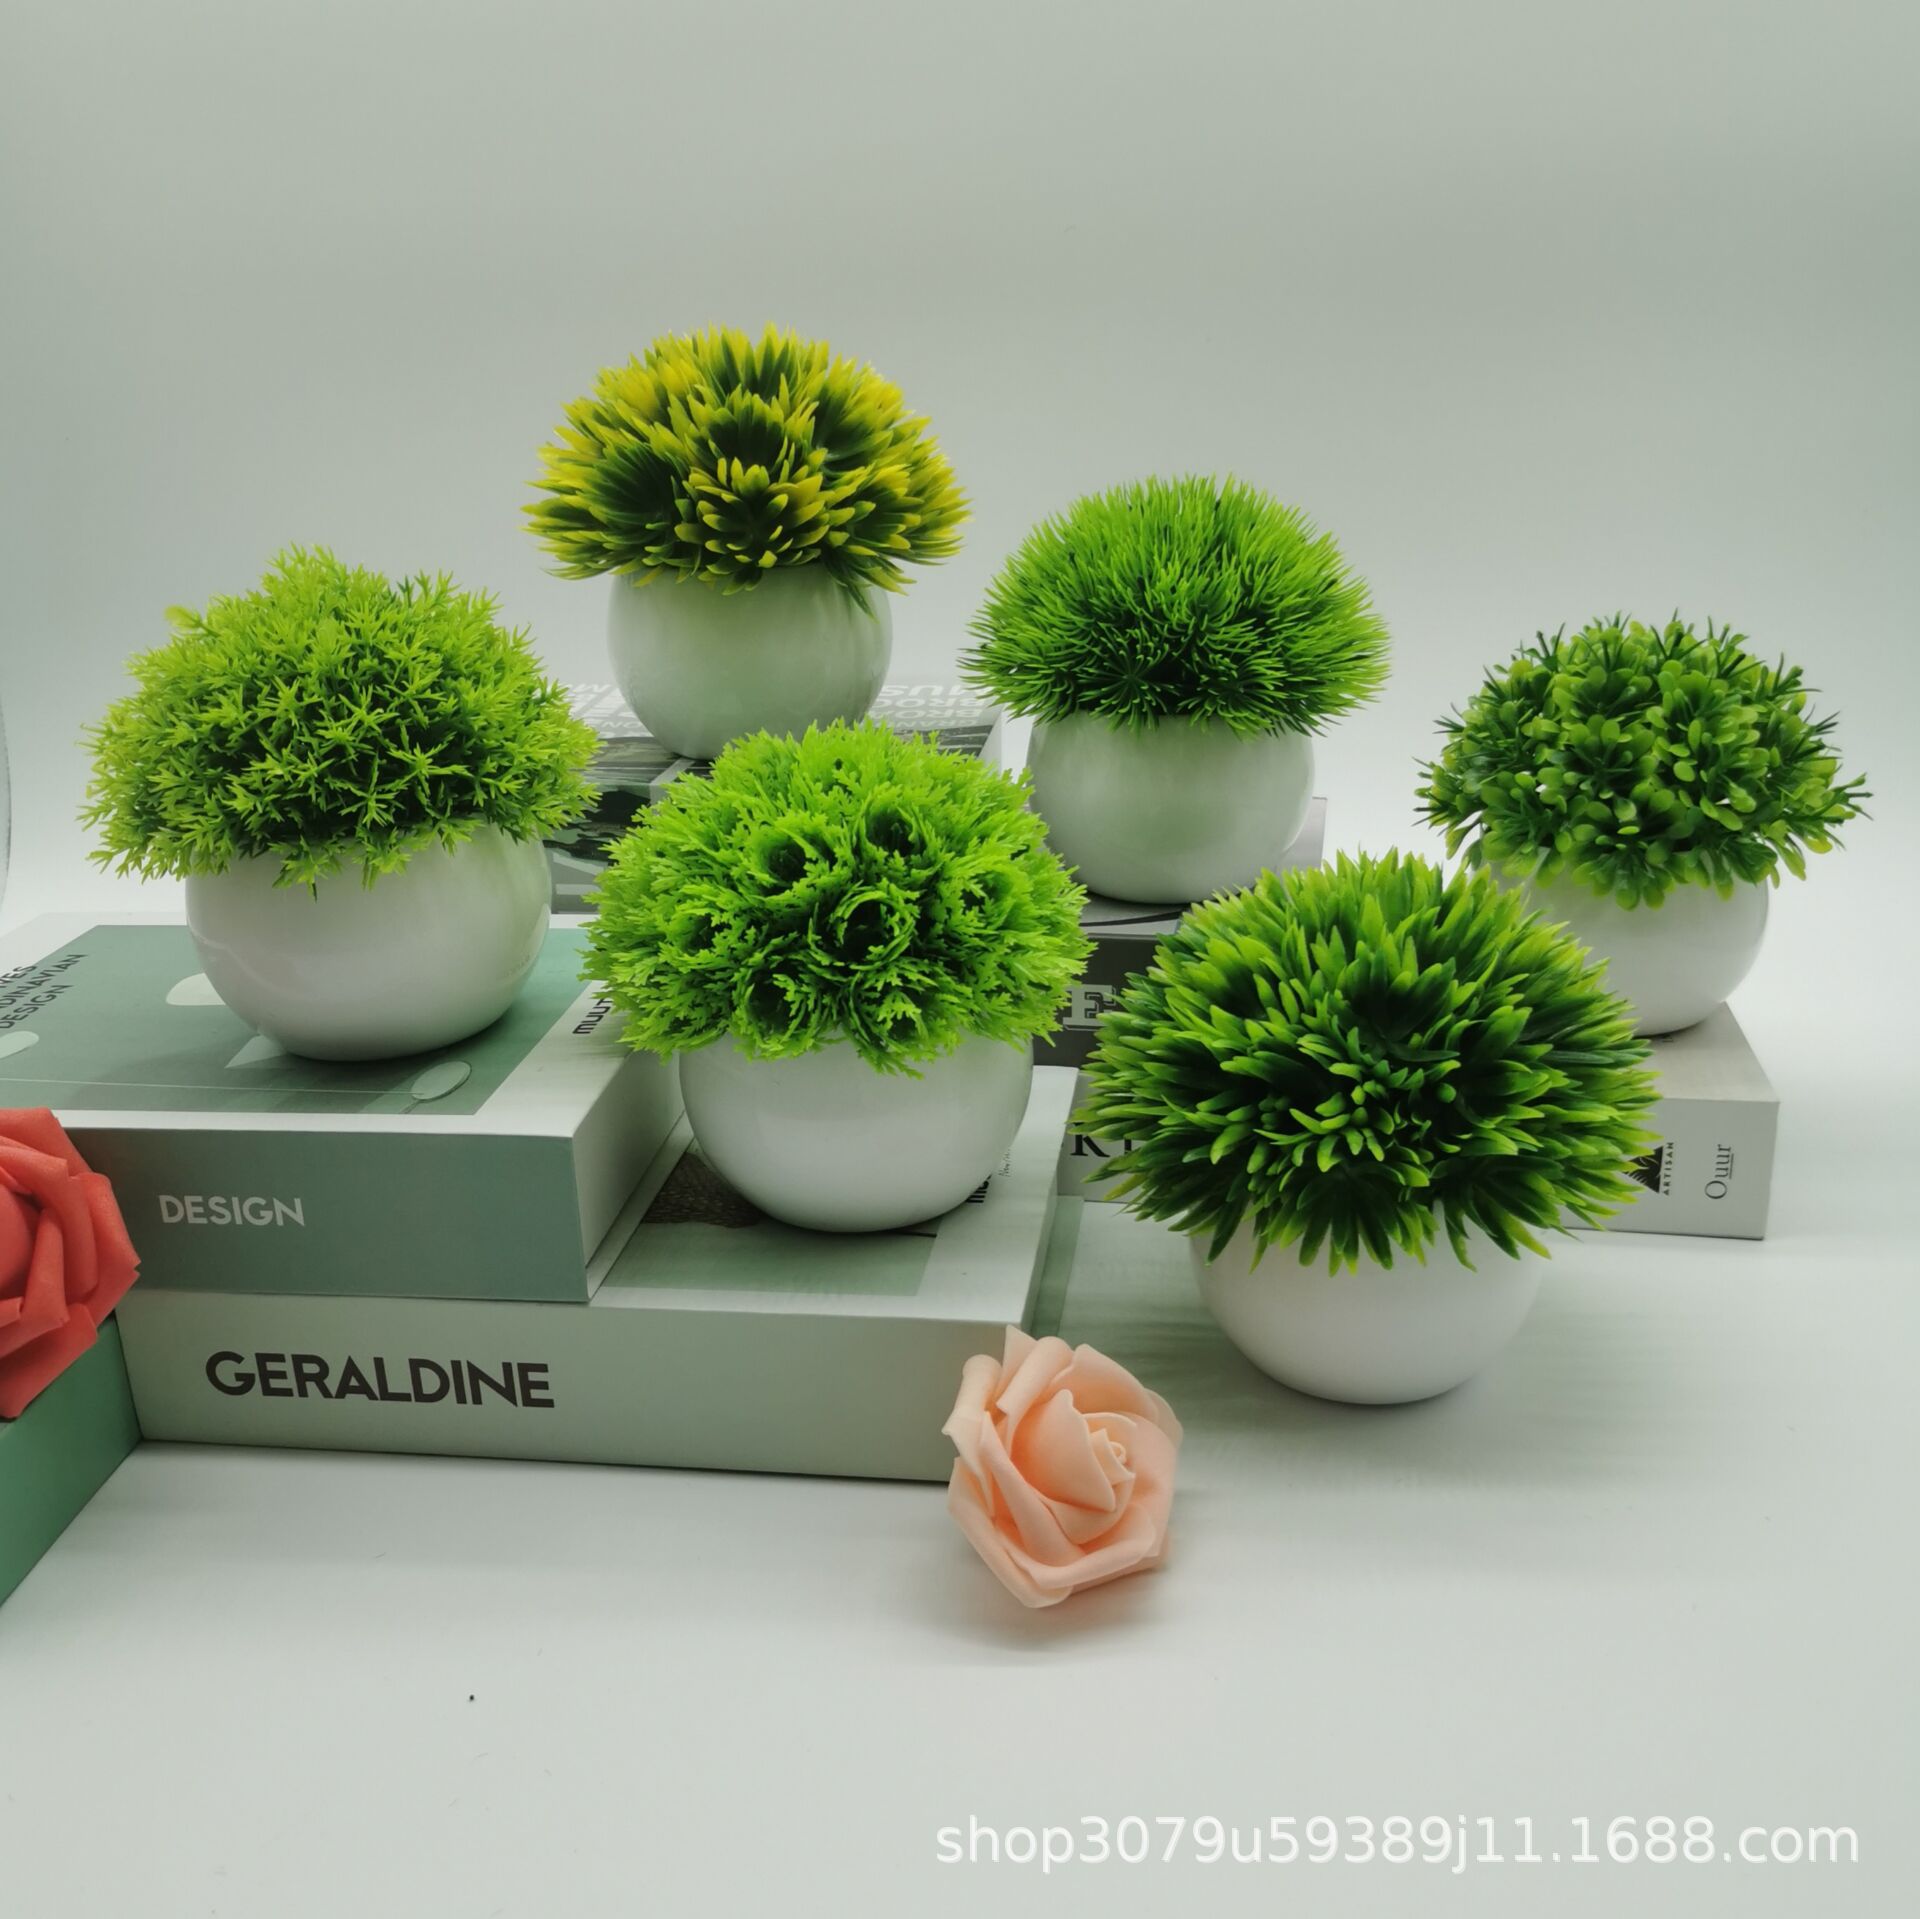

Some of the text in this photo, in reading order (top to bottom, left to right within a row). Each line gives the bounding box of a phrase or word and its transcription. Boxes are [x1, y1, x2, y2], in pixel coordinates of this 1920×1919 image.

[1663, 1142, 1674, 1196] ARTISAN
[1705, 1144, 1731, 1199] Ouur
[159, 1194, 305, 1227] DESIGN
[205, 1350, 555, 1409] GERALDINE
